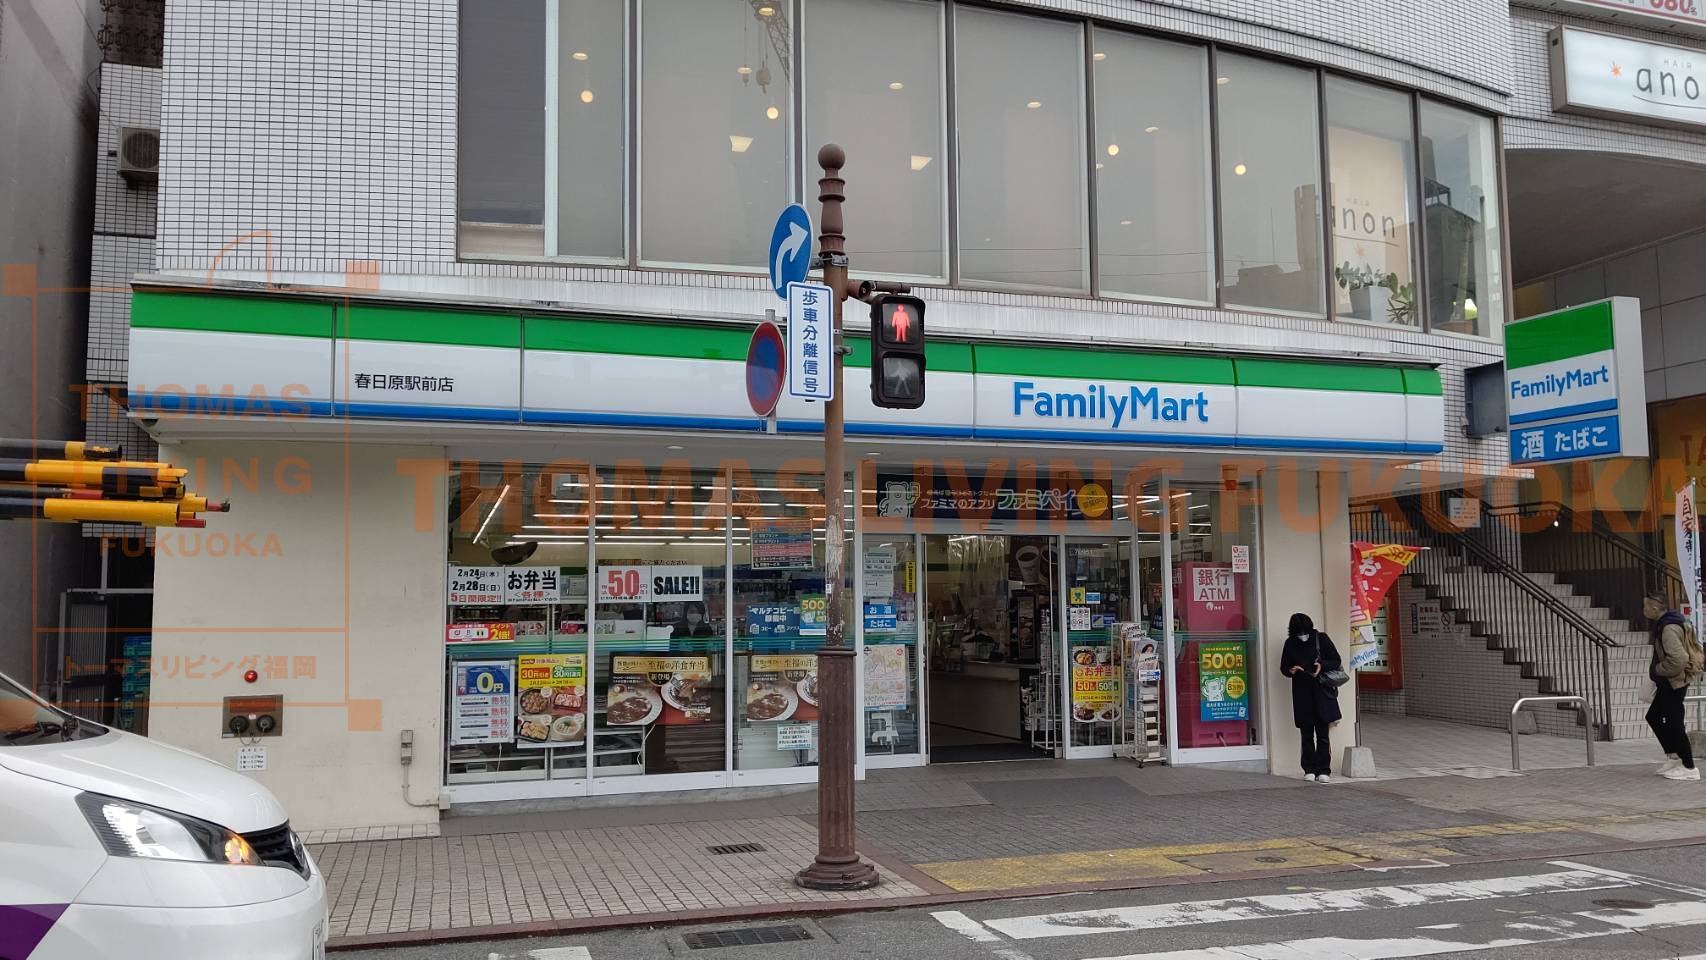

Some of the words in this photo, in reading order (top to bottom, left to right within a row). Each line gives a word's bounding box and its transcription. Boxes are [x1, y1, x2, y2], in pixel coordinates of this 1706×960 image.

[1663, 58, 1692, 69] HAIR
[802, 290, 819, 393] 歩車分離信号
[354, 373, 454, 393] 春日原駅前店
[1511, 364, 1609, 400] FamilyMart
[1013, 381, 1209, 429] FamilyMart
[1521, 430, 1545, 459] 酒
[1554, 425, 1609, 453] たばこ
[920, 498, 995, 509] ファミマのアプリ
[996, 488, 1076, 510] ファミペイ
[507, 569, 557, 591] お弁当
[653, 576, 700, 596] SALE!!
[1199, 568, 1230, 586] 銀行
[1199, 587, 1231, 601] ATM
[870, 619, 892, 628] たばこ
[476, 671, 504, 694] 0円
